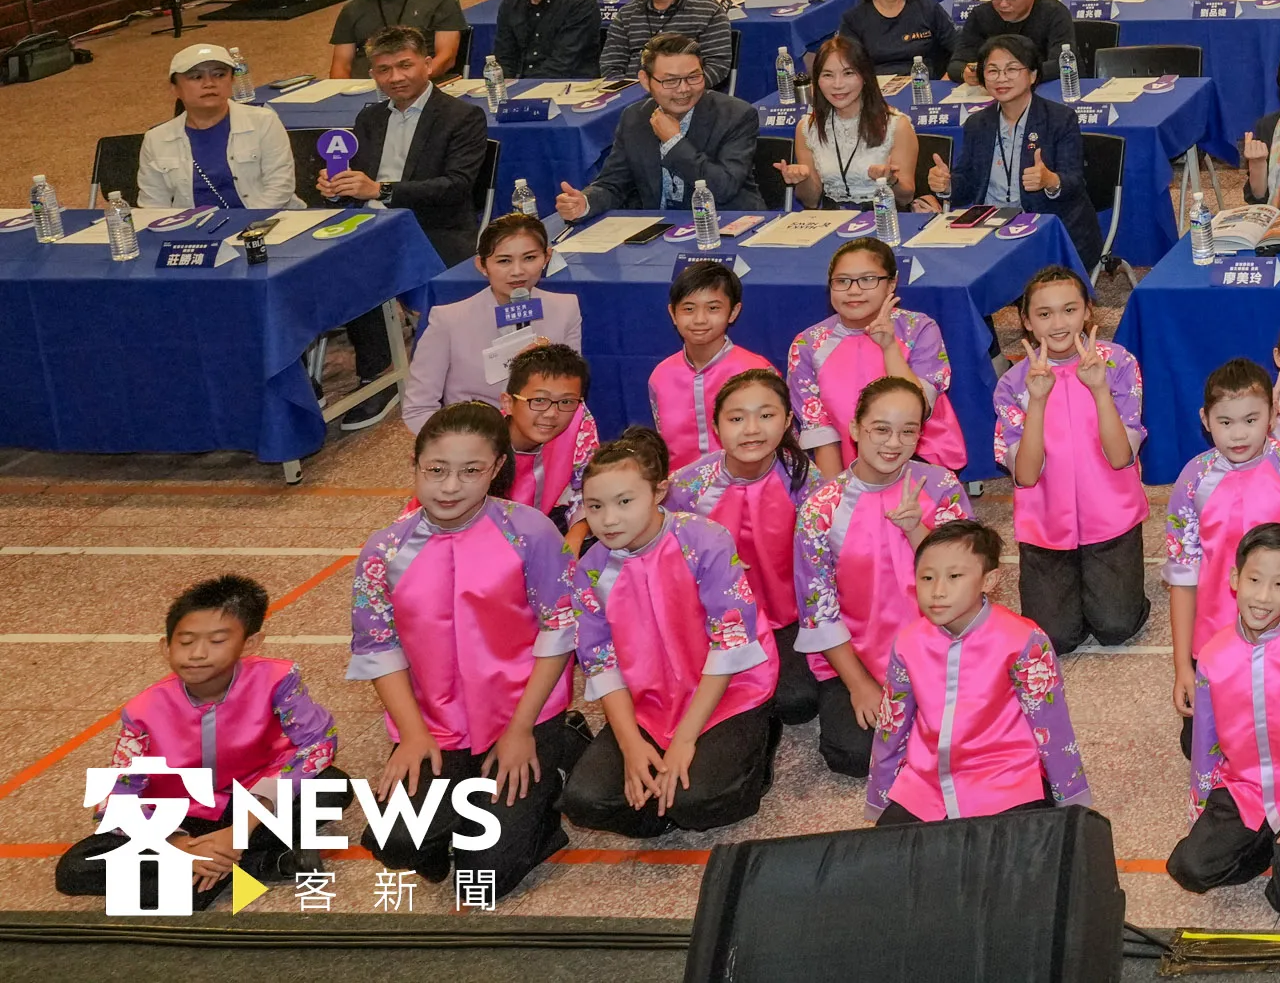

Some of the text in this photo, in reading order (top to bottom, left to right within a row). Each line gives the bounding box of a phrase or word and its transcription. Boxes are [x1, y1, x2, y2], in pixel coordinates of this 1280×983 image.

[765, 114, 797, 126] 周聖心
[917, 114, 949, 126] 湯昇榮
[325, 135, 349, 154] A
[166, 252, 204, 266] 莊勝鴻
[1222, 271, 1263, 285] 廖美玲
